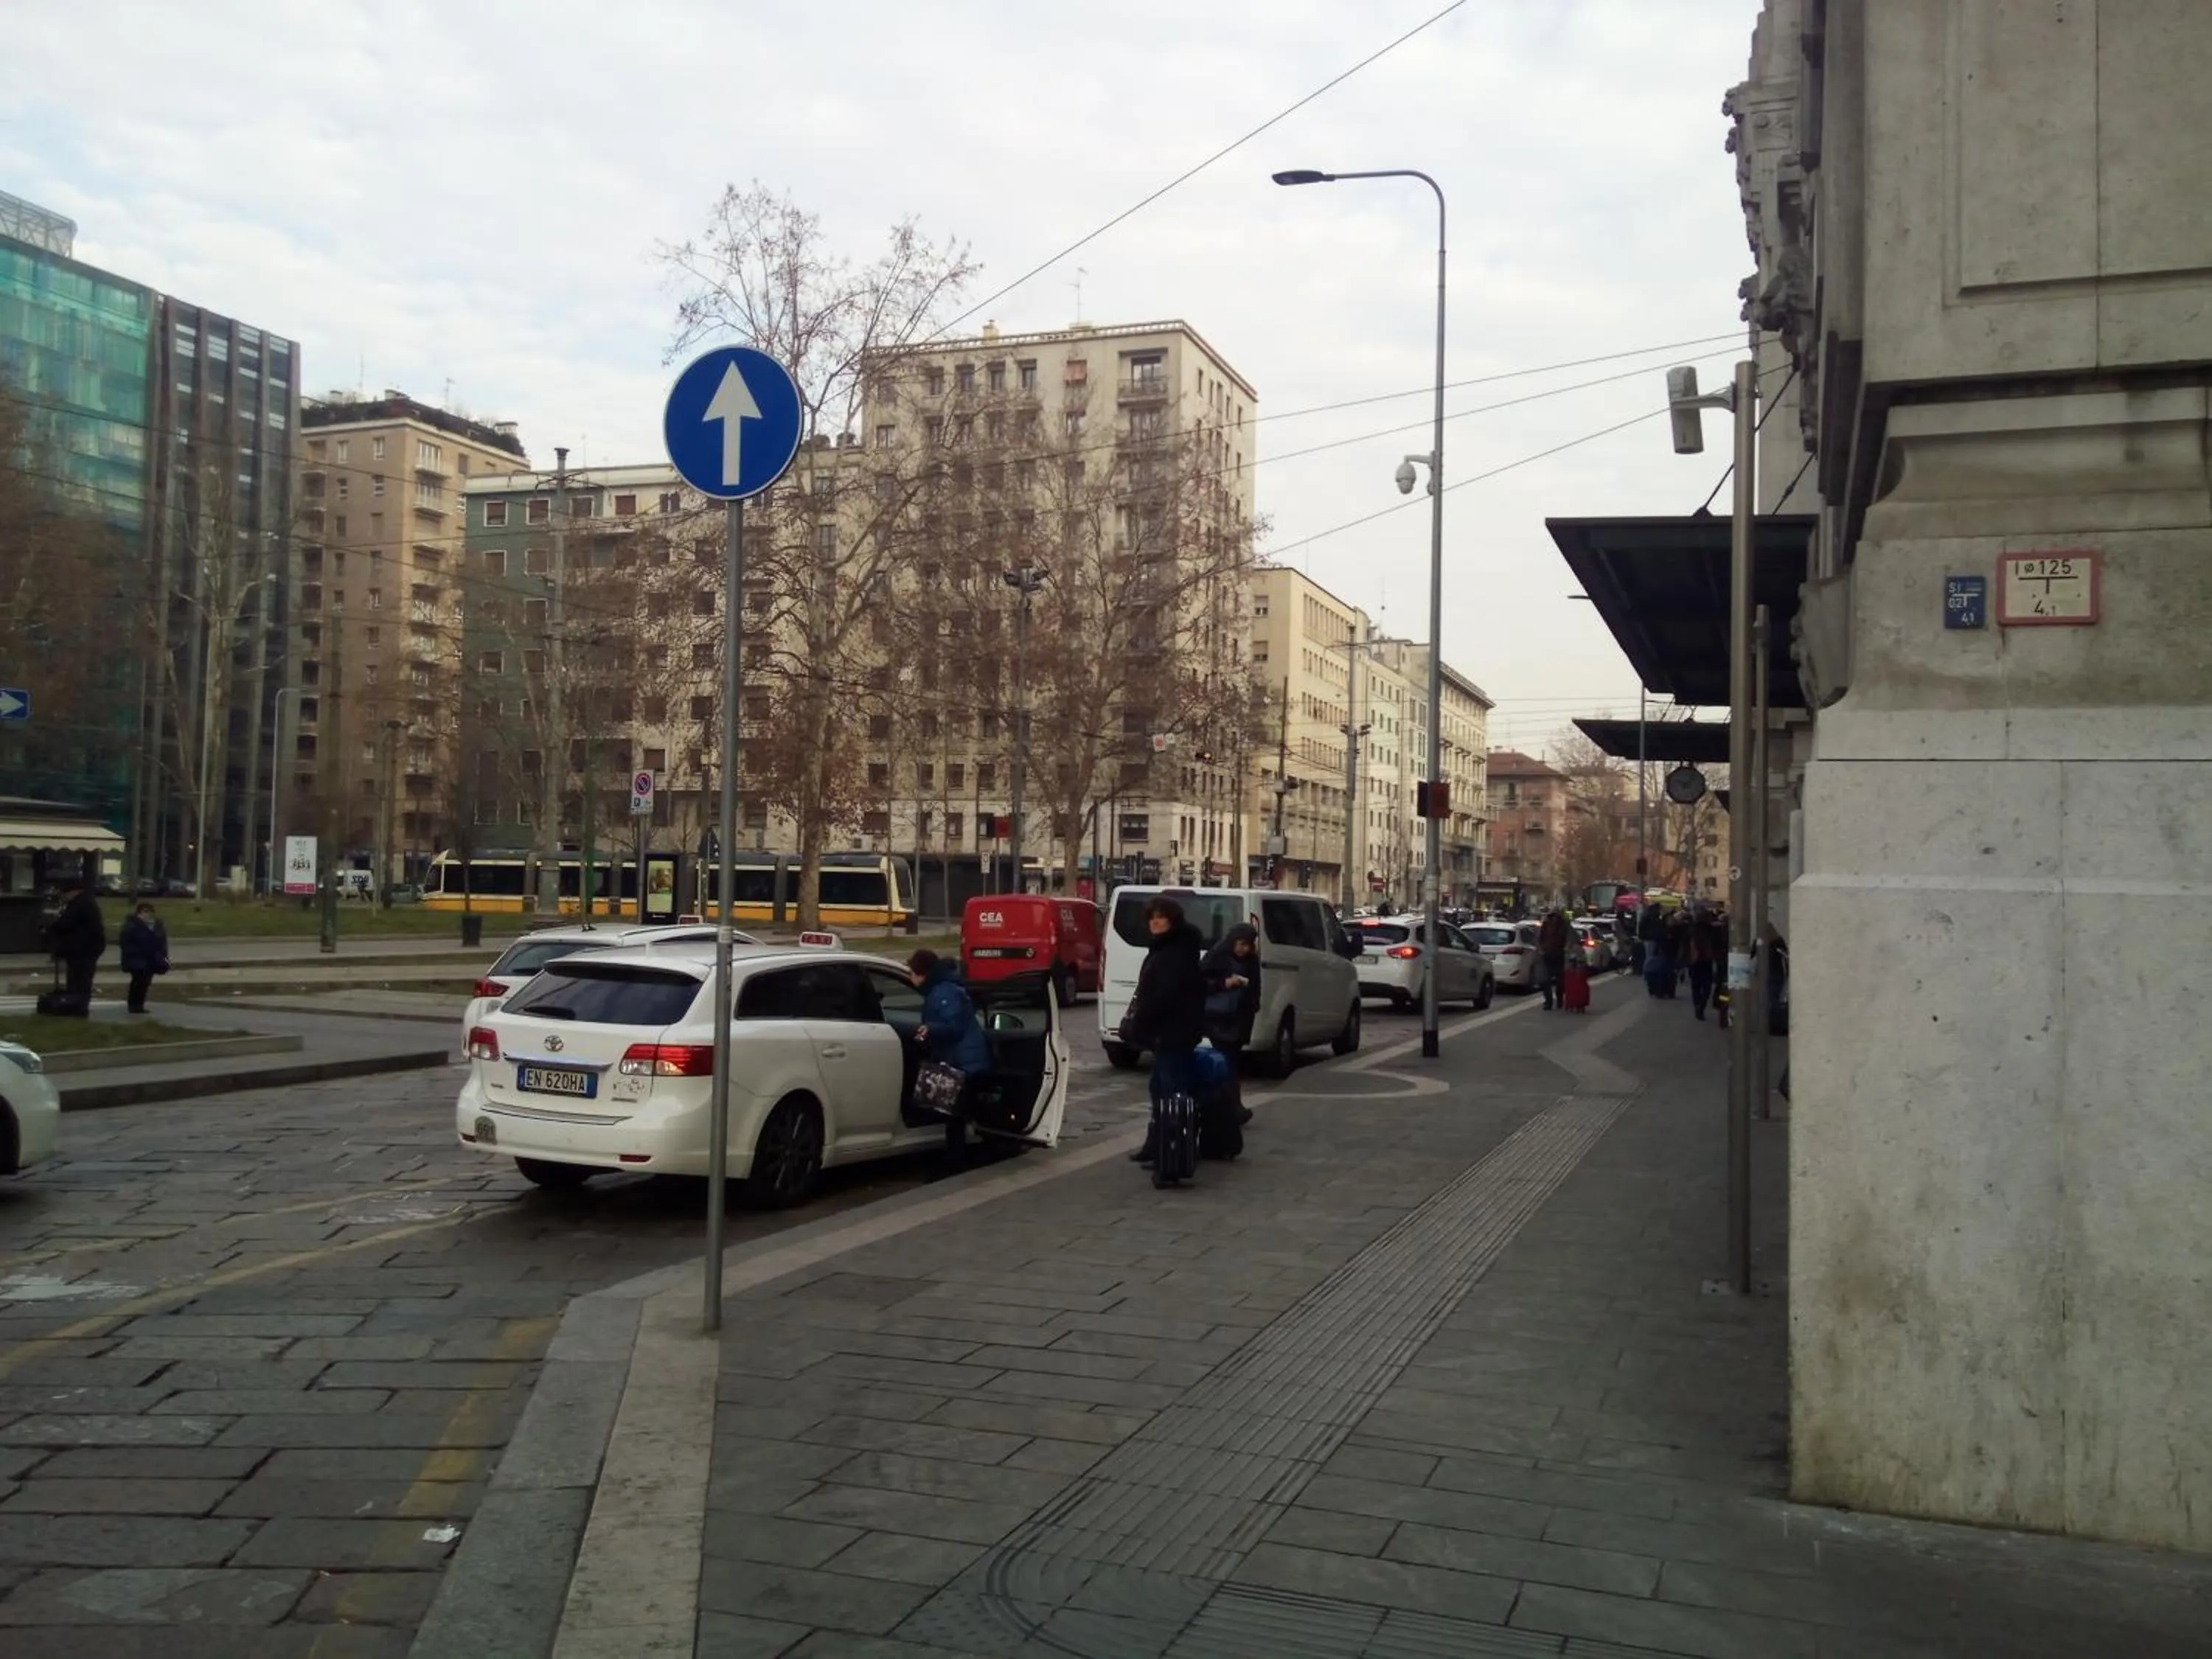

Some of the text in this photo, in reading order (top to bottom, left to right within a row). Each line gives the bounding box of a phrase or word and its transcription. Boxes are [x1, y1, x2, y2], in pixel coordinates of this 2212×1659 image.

[979, 911, 1004, 922] CEA
[801, 934, 832, 945] TAXI
[526, 1070, 585, 1092] EN 620HA
